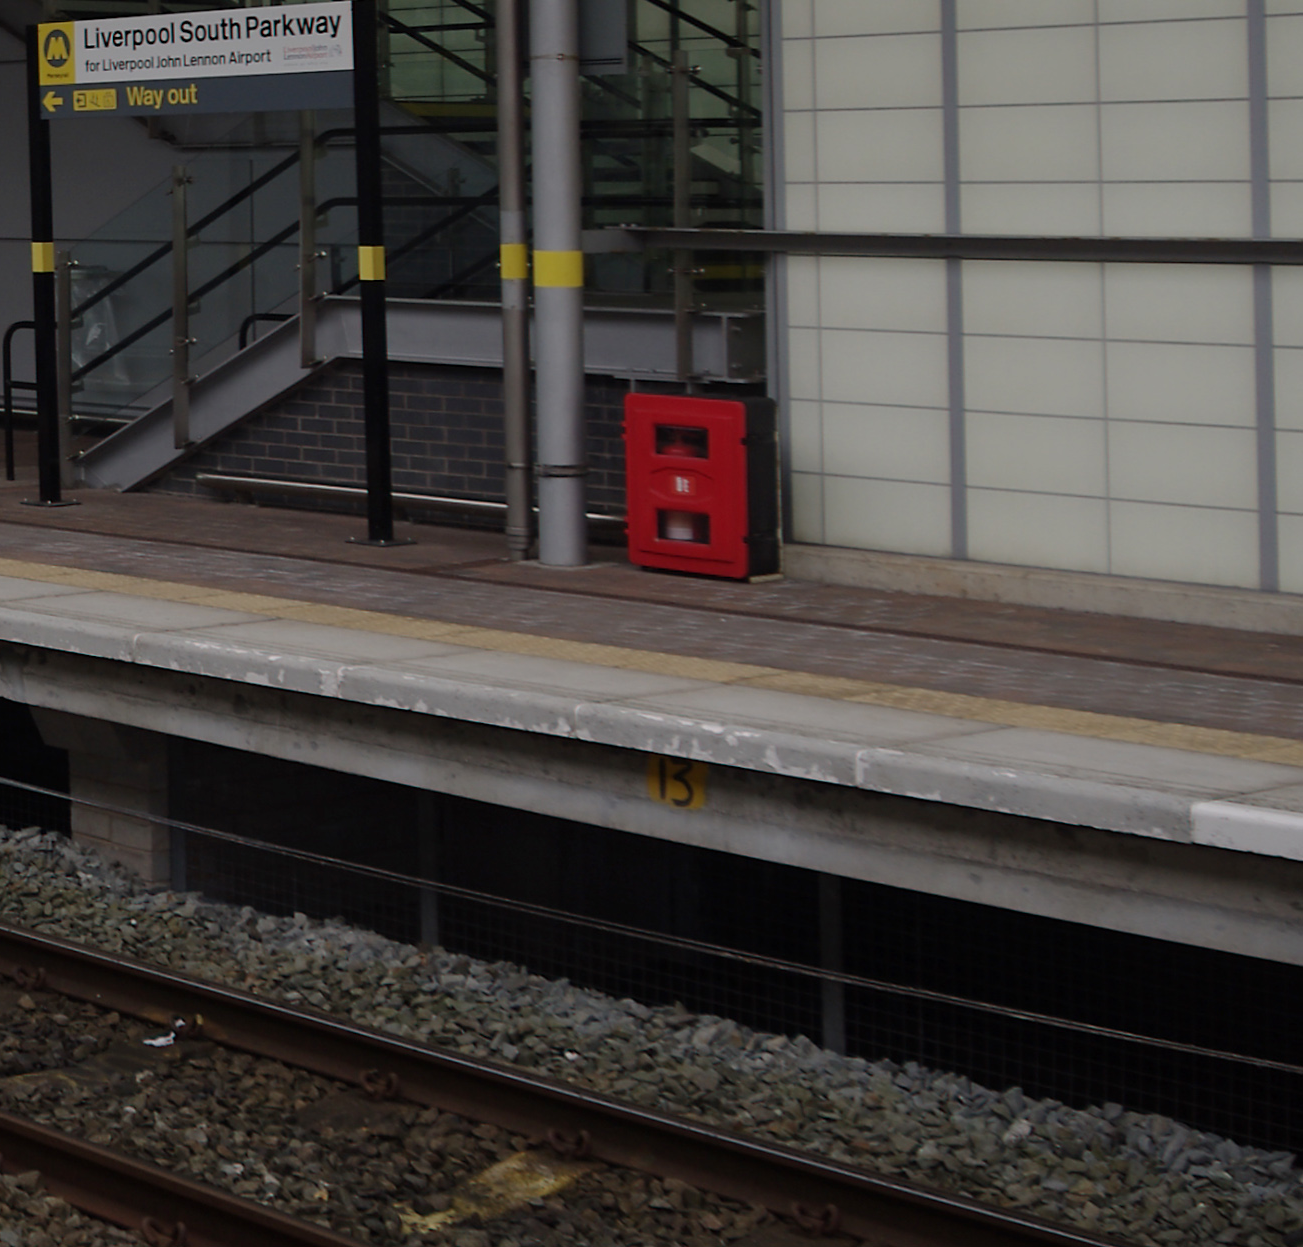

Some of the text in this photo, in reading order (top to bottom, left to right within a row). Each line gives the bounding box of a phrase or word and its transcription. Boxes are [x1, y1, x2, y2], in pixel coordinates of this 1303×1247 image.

[84, 13, 342, 51] Liverpool South Parkway
[85, 49, 271, 72] for Liverpool John Lennon Airport
[125, 83, 199, 110] Way out
[659, 756, 694, 807] 13
